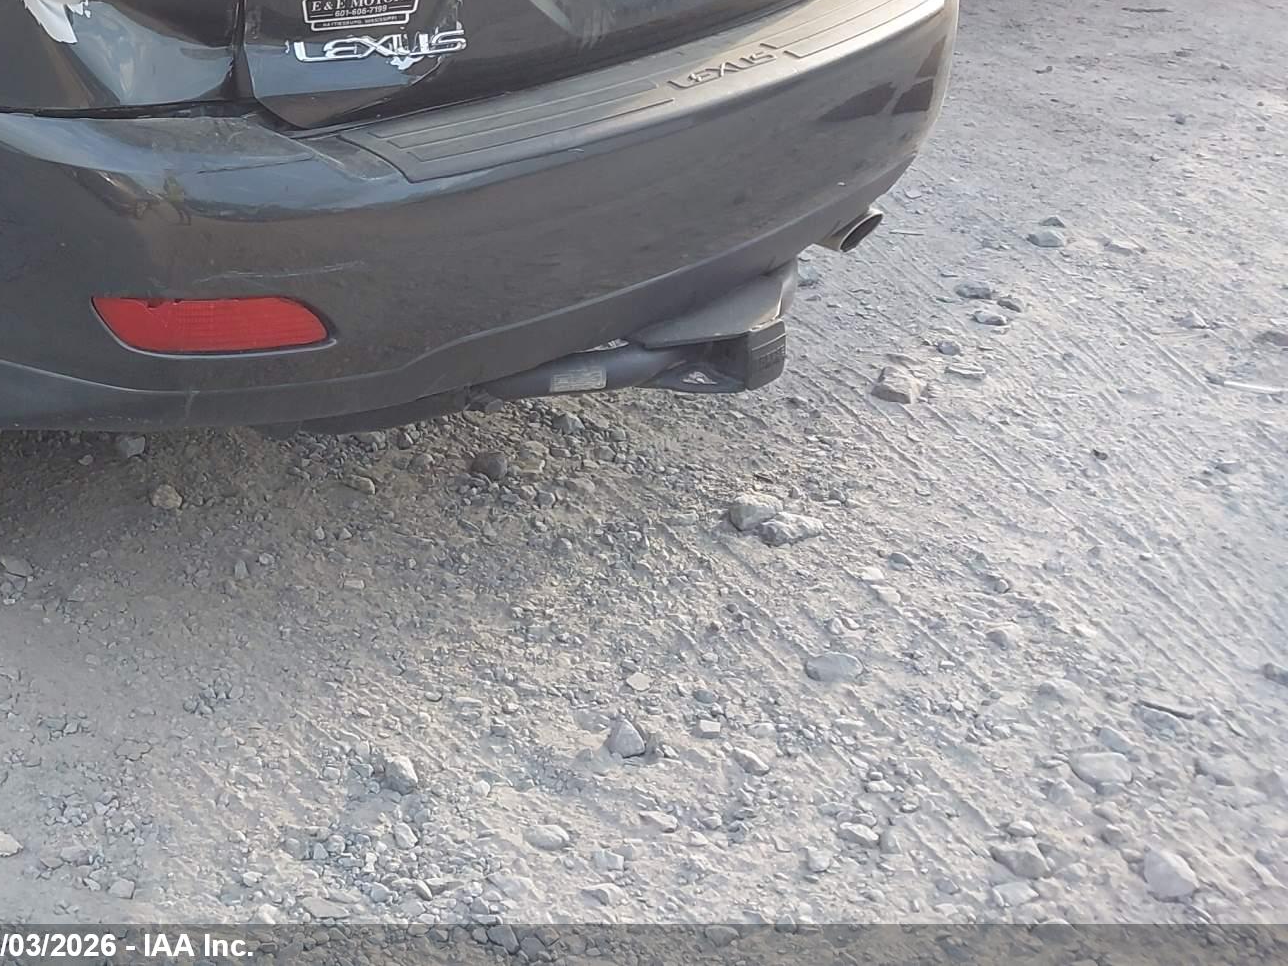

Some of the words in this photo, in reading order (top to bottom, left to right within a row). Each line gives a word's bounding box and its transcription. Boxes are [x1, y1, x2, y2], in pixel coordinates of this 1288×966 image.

[311, 0, 322, 12] E
[323, 0, 334, 11] &
[294, 29, 468, 63] LEXUS
[667, 49, 778, 89] LEXUS
